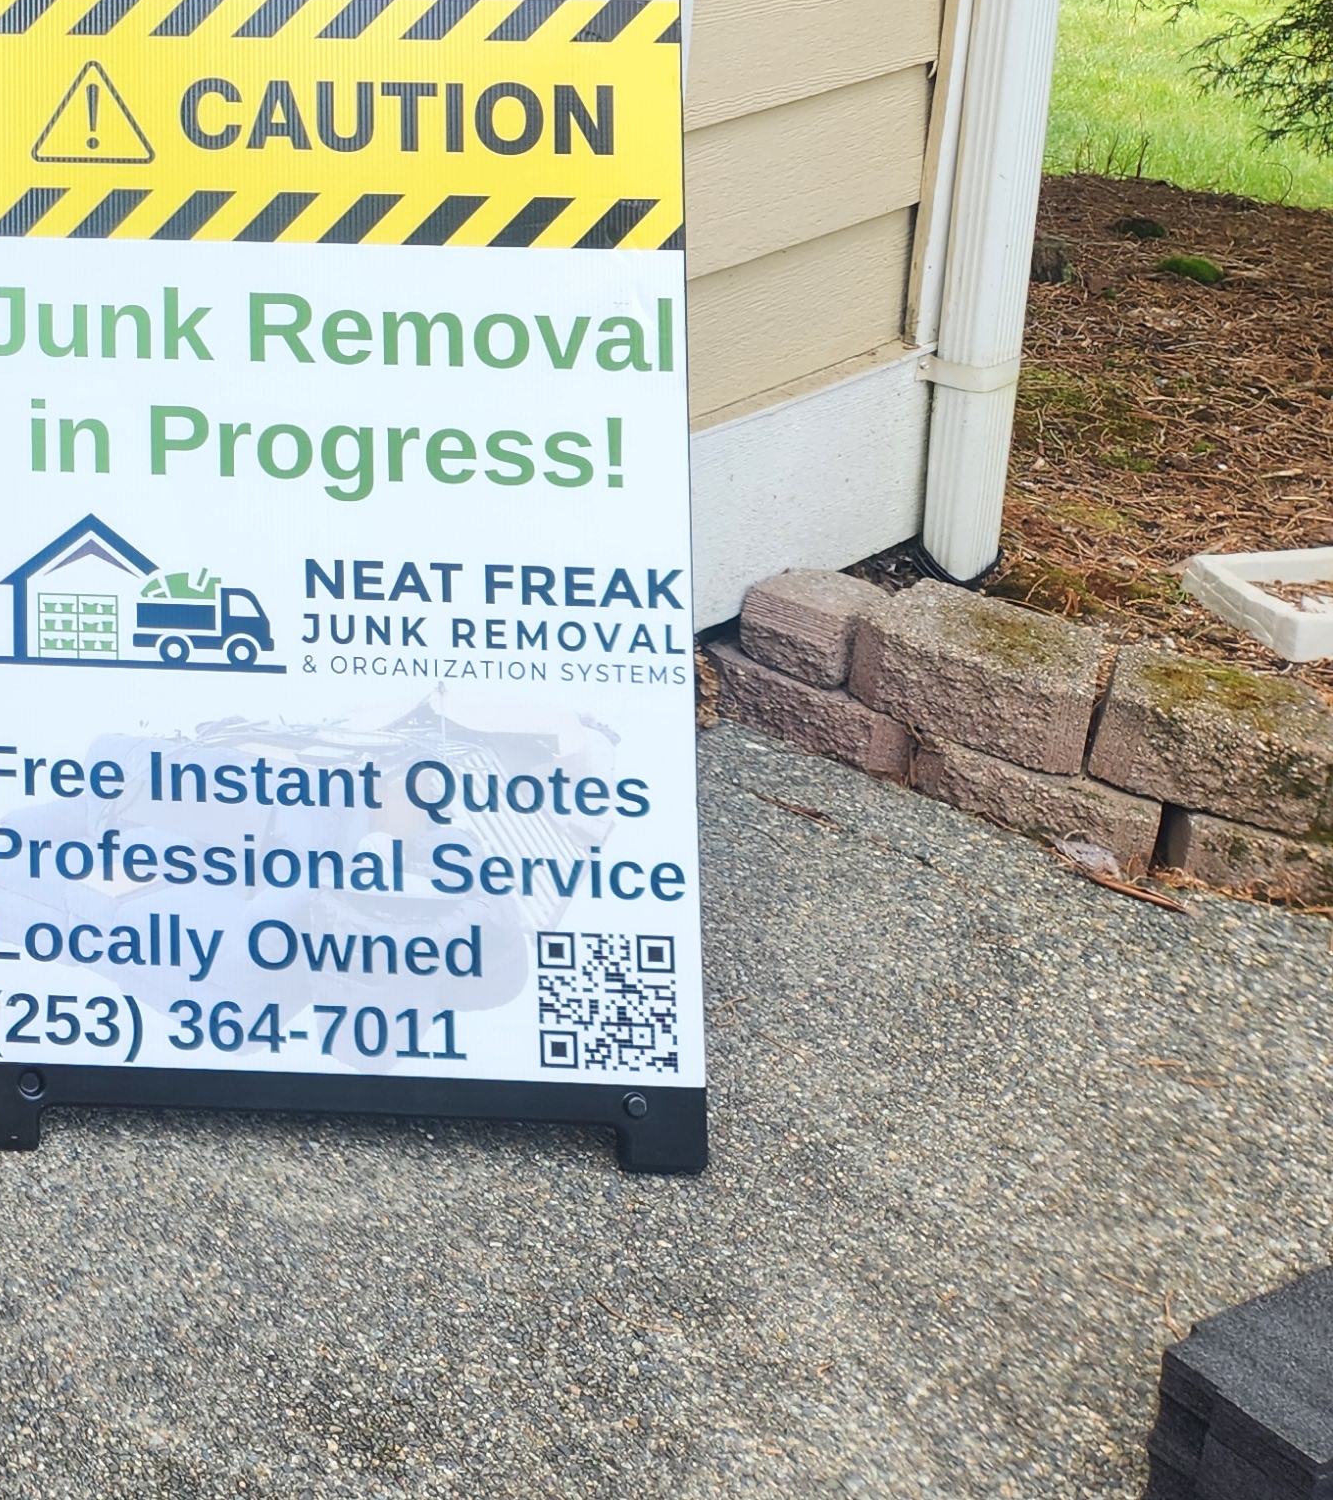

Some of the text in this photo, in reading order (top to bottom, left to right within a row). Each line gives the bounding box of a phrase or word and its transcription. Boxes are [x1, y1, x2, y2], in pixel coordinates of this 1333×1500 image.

[179, 77, 614, 156] CAUTION
[250, 290, 675, 373] Removal
[29, 397, 626, 503] in Progress!
[303, 557, 685, 611] NEAT FREAK
[301, 613, 688, 656] JUNK REMOVAL
[302, 654, 688, 686] & ORGANIZATION SYSTEMS
[149, 751, 383, 810] Instant
[404, 759, 652, 823] Quotes
[430, 841, 687, 903] Service
[247, 918, 484, 979] Owned
[168, 998, 468, 1062] 364-7011
